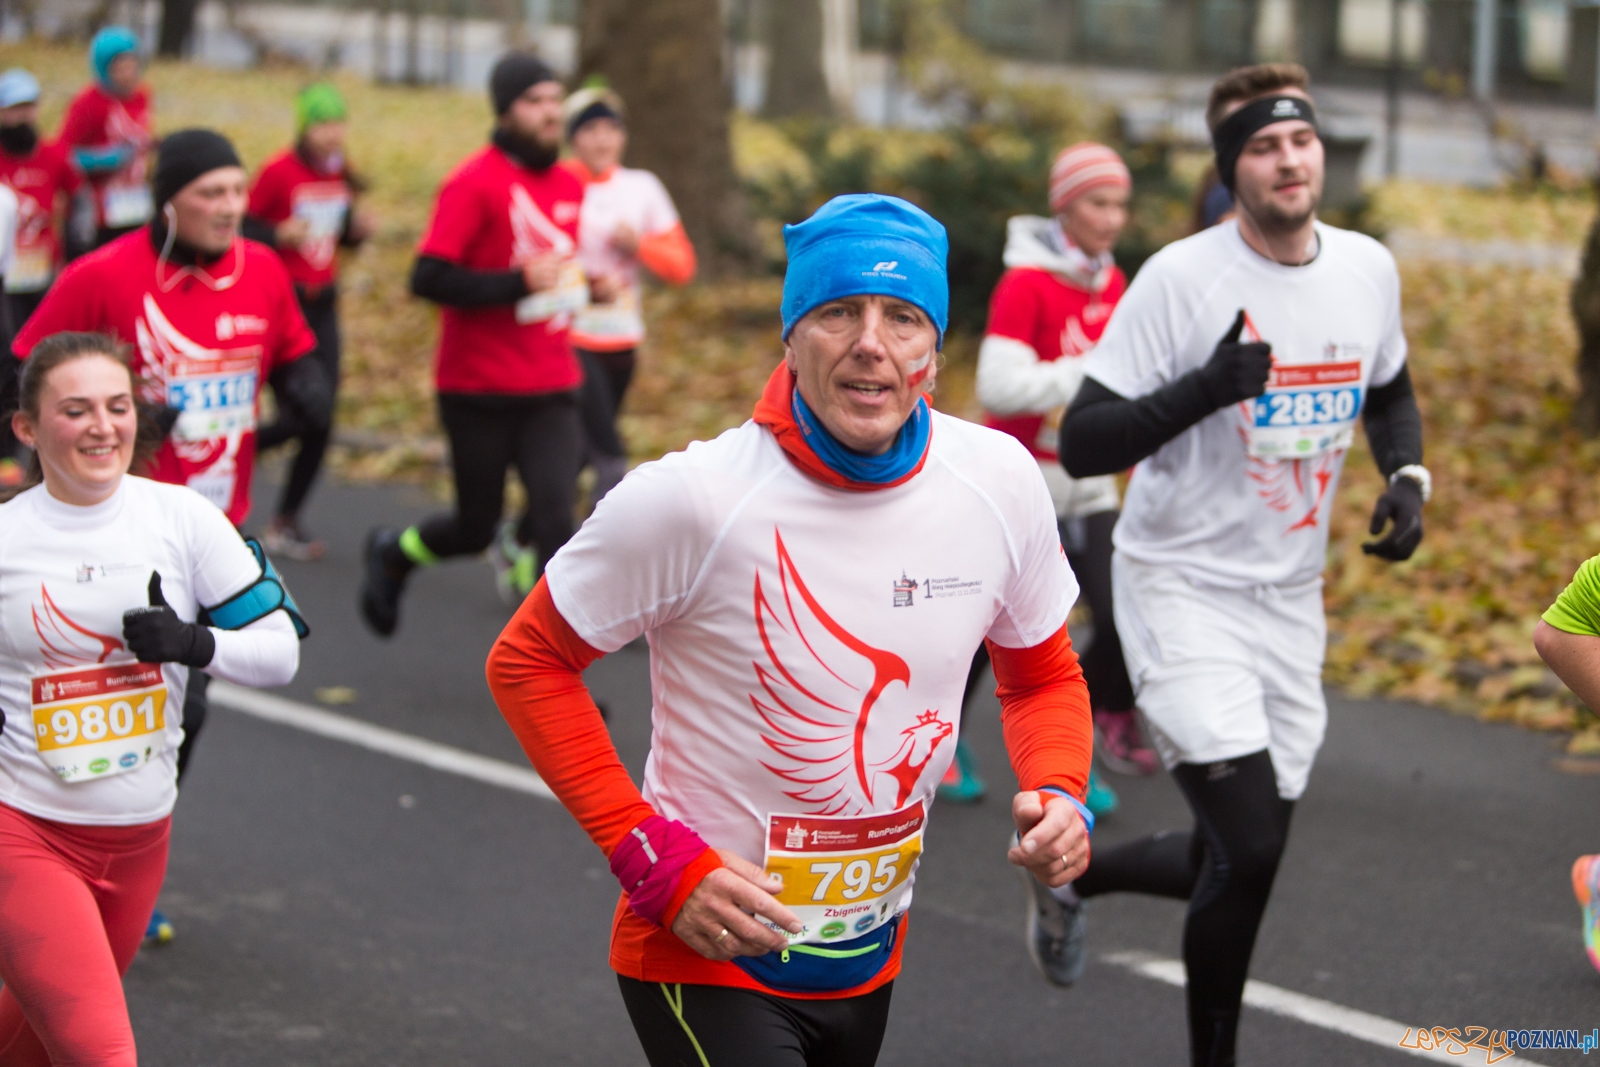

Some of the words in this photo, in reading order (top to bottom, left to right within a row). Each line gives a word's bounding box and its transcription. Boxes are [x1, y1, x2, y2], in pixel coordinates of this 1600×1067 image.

[1269, 389, 1355, 425] 2830
[50, 695, 156, 745] 9801
[867, 817, 920, 839] RunPoland.org
[810, 852, 900, 901] 795
[824, 904, 872, 918] Zbigniew
